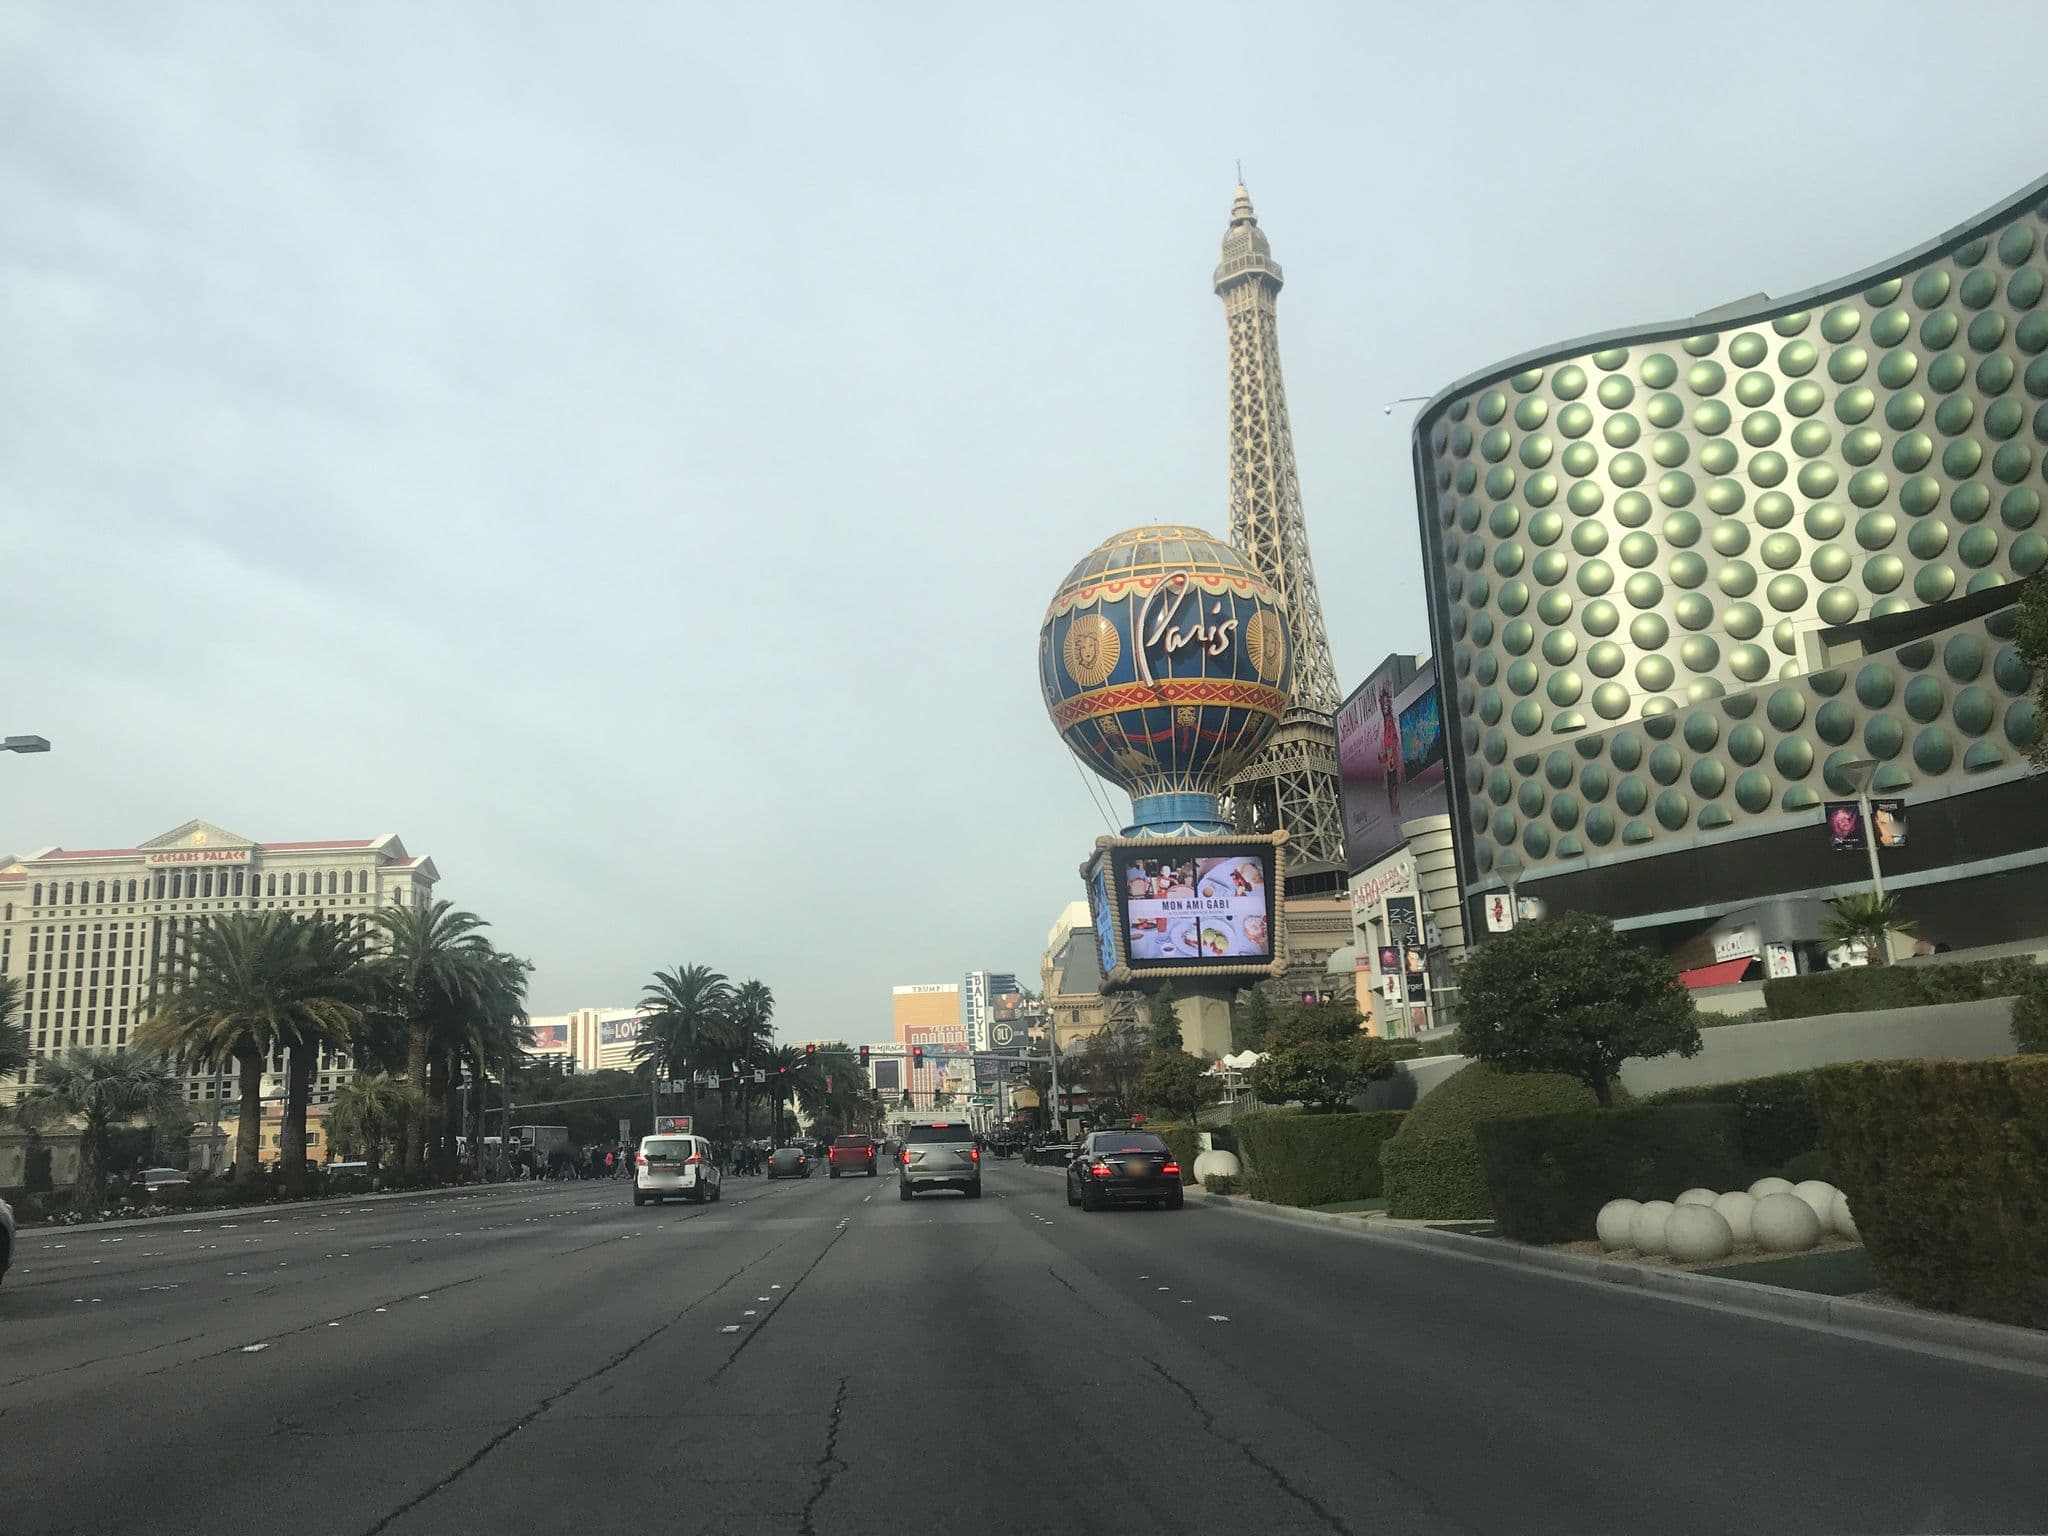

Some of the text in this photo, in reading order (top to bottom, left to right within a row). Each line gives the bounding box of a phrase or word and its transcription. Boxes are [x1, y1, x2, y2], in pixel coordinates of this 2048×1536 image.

[1137, 569, 1238, 687] Paris
[151, 851, 246, 863] CAESARS PALACE
[1162, 899, 1229, 911] MON AMI GABI
[1402, 907, 1418, 946] MSAY
[877, 1044, 904, 1052] MIRAGE
